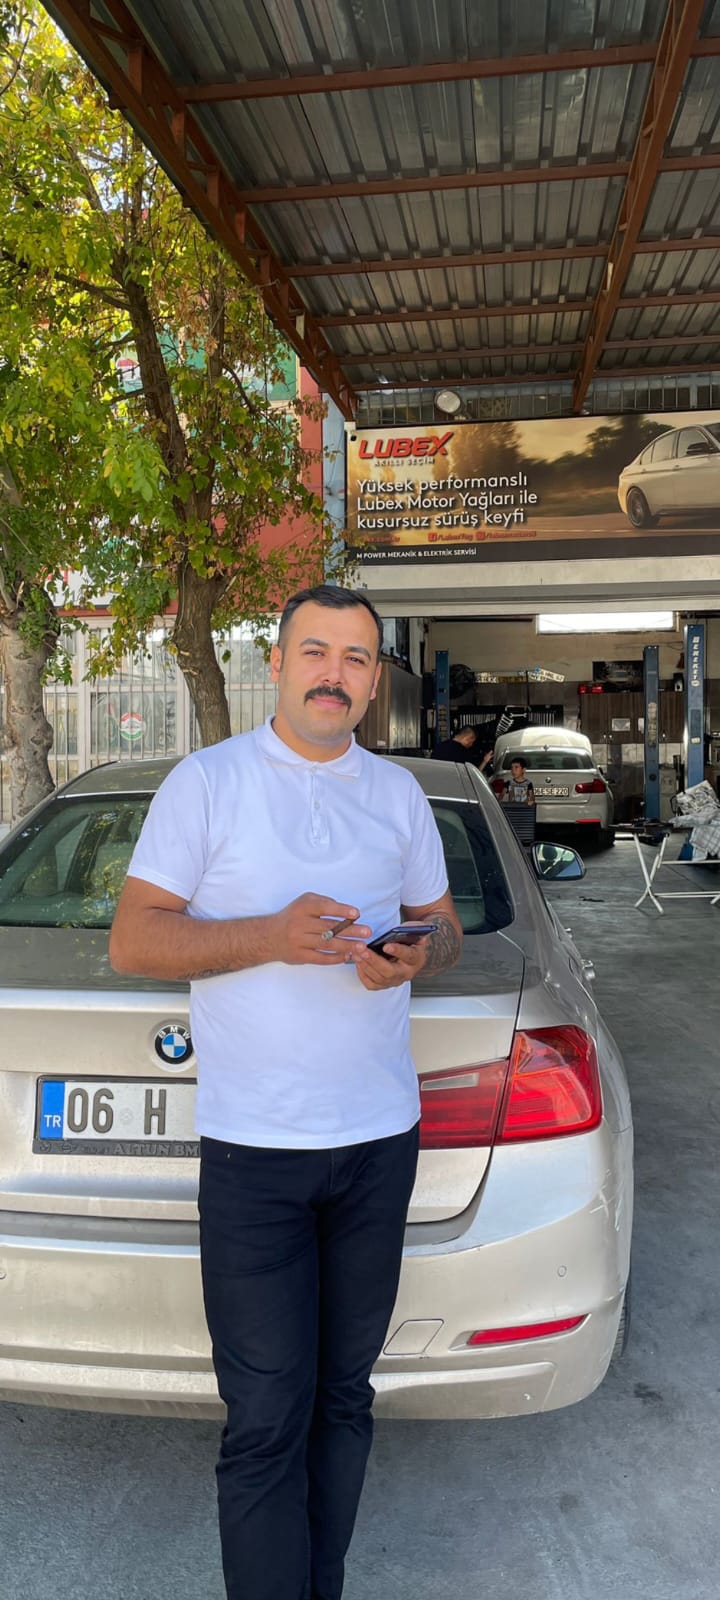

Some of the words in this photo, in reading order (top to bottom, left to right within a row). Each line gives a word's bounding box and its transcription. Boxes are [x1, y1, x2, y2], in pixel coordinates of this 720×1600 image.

[359, 431, 454, 459] LUBEX
[357, 479, 413, 494] Yüksek
[418, 471, 527, 492] performanslı
[357, 497, 403, 511] Lubex
[408, 496, 454, 510] Motor
[459, 491, 514, 510] Yağları
[519, 490, 538, 505] ile
[357, 515, 429, 529] kusursuz
[435, 512, 479, 527] sürüş
[484, 508, 524, 528] keyfi
[388, 550, 416, 558] MEKANİK
[424, 549, 452, 557] ELEKTRİK
[454, 547, 476, 556] SERVİSİ
[158, 1026, 190, 1040] BMW
[44, 1114, 62, 1128] TR
[67, 1087, 114, 1134] 06
[144, 1089, 166, 1135] H
[114, 1143, 170, 1157] ALTUN
[175, 1144, 199, 1157] BM
